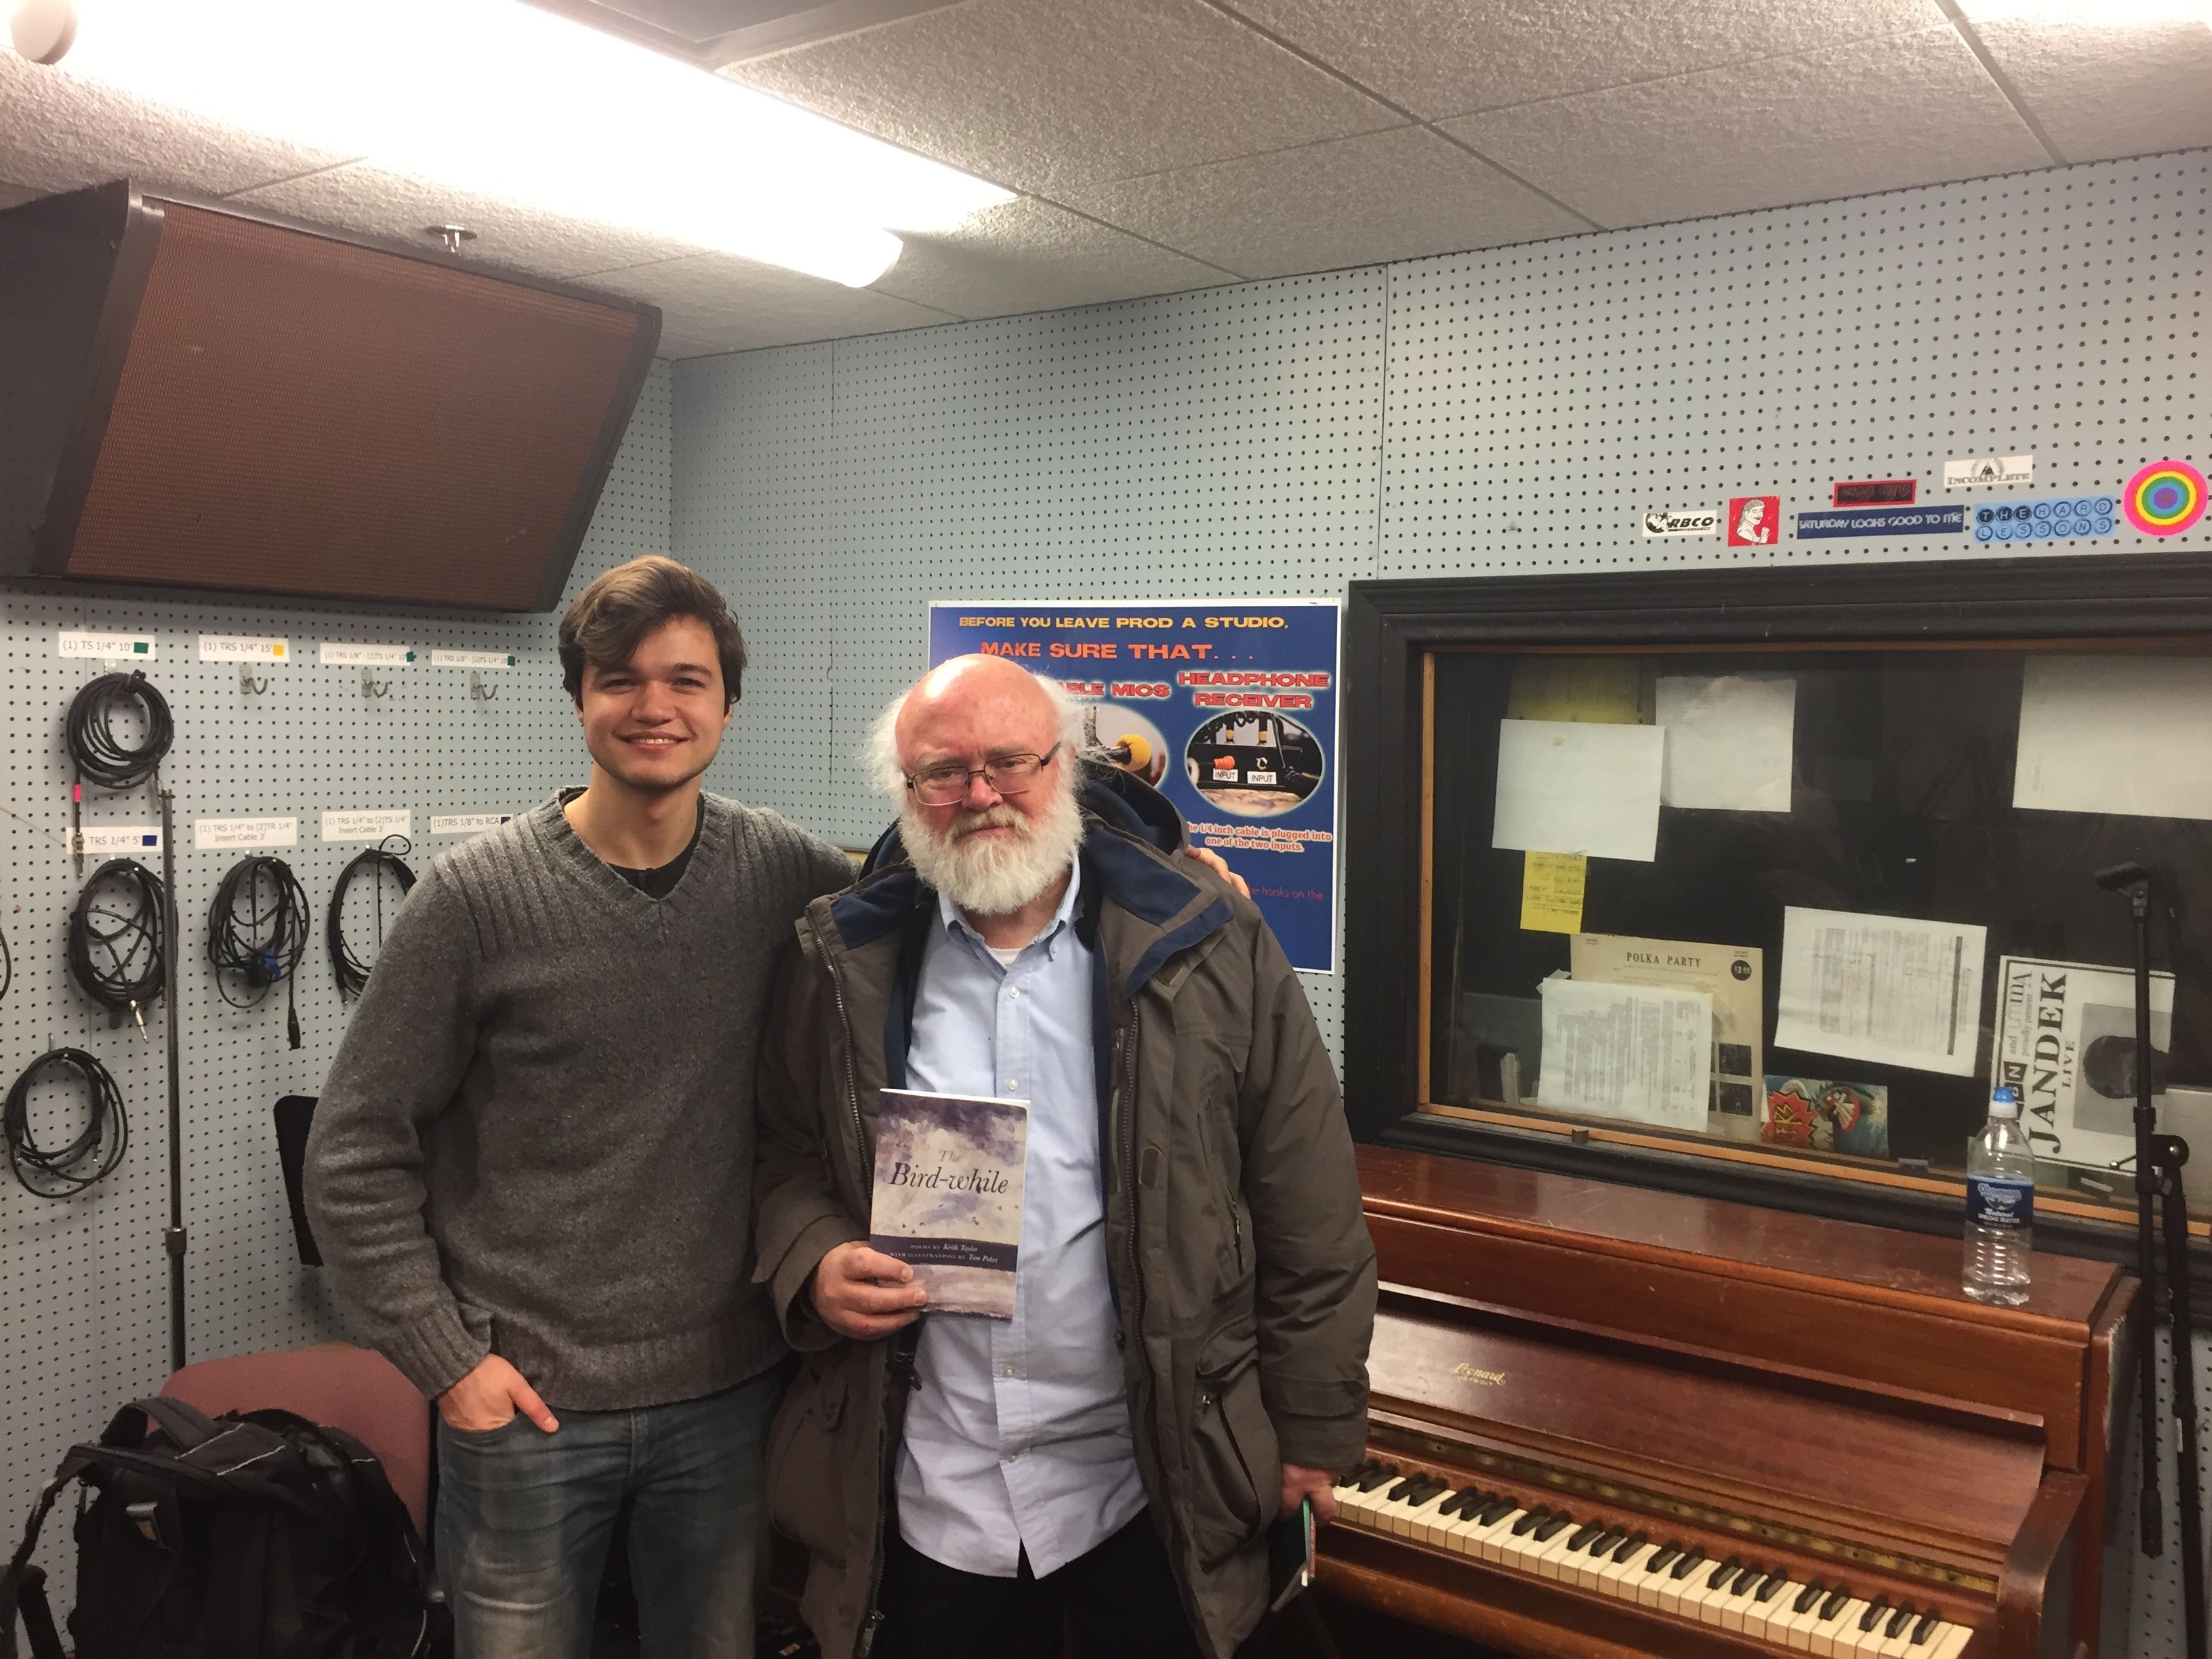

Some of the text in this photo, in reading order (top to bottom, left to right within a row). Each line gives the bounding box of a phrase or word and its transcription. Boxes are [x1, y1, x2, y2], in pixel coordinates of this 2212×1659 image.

[1946, 473, 2030, 485] INCOMPLETE
[1977, 505, 2032, 524] THE
[2034, 498, 2113, 518] HARD
[1888, 514, 1923, 527] GOOD
[1925, 513, 1941, 525] TO
[1976, 517, 2113, 541] LESSONS
[959, 617, 1015, 628] BEFORE
[1020, 617, 1051, 628] YOU
[1055, 617, 1109, 628] LEAVE
[1115, 617, 1174, 629] PROD
[1181, 617, 1196, 629] A
[62, 640, 77, 651] (1)
[81, 640, 94, 650] TS
[203, 641, 218, 652] (1)
[220, 642, 237, 651] TRS
[980, 641, 1041, 657] MAKE
[1049, 642, 1117, 659] SURE
[1179, 672, 1330, 687] HEADPHONE
[1059, 682, 1170, 697] BLE MICS
[1194, 693, 1312, 709] RECEIVER
[199, 825, 211, 834] (1)
[213, 824, 229, 832] TRS
[1200, 824, 1212, 833] 1/4
[1214, 825, 1233, 834] inch
[1235, 826, 1259, 836] cable
[1261, 827, 1269, 836] is
[1271, 828, 1309, 842] plugged
[1312, 831, 1332, 840] into
[89, 836, 107, 845] TRS
[214, 834, 236, 842] Insert
[238, 833, 258, 841] Cable
[1235, 838, 1250, 846] the
[1251, 840, 1269, 848] two
[1292, 890, 1305, 899] on
[1307, 888, 1324, 900] the
[1626, 952, 1702, 968] POLKA PARTY
[2007, 1036, 2017, 1054] and
[2028, 972, 2067, 1154] JANDEK
[2062, 1040, 2075, 1088] LIVE
[939, 1150, 961, 1163] The
[888, 1162, 1009, 1194] Bird-while
